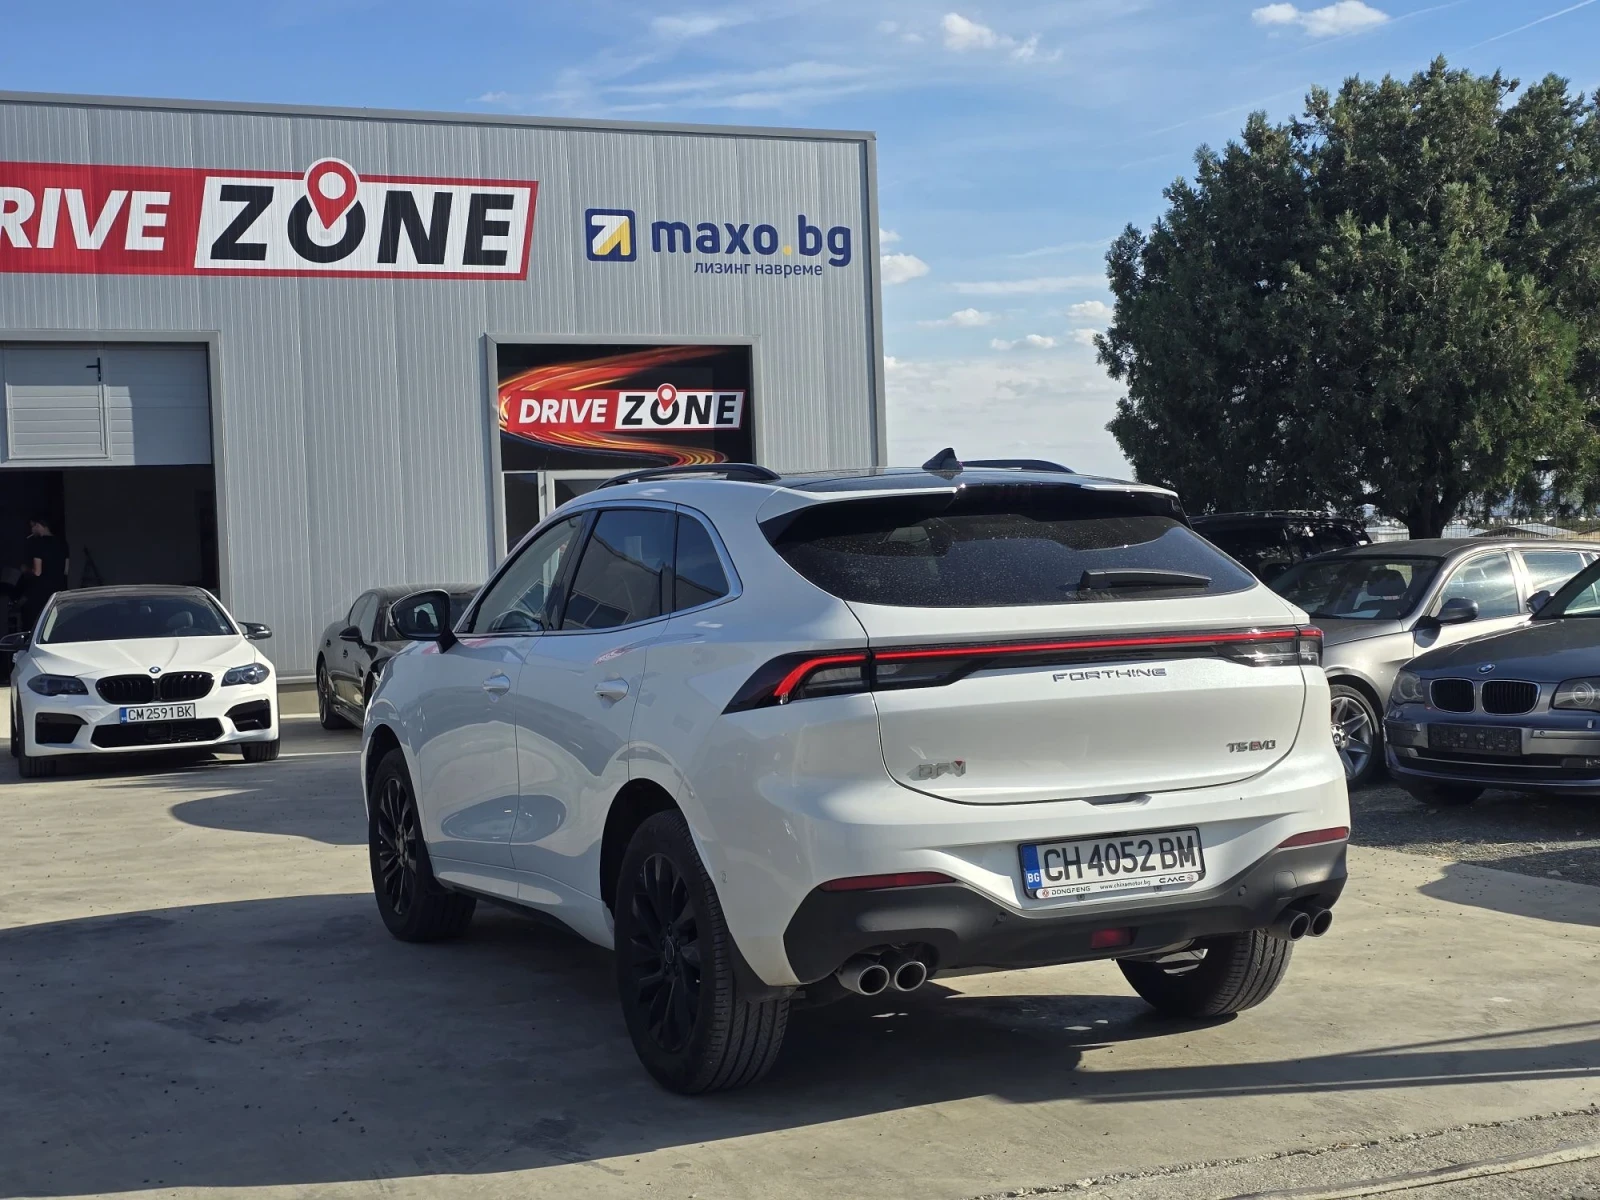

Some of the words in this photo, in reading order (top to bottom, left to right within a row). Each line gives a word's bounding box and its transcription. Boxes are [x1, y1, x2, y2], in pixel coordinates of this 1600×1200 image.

[210, 183, 515, 267] ZONE
[651, 214, 851, 268] maxo.bg
[694, 261, 751, 275] лизинг
[755, 263, 823, 278] навреме
[518, 398, 608, 425] DRIVE
[621, 394, 737, 426] ZONE
[1087, 839, 1157, 877] 4052
[1027, 872, 1040, 883] BG
[1051, 885, 1091, 896] DONGFENG
[1158, 875, 1186, 884] CMC
